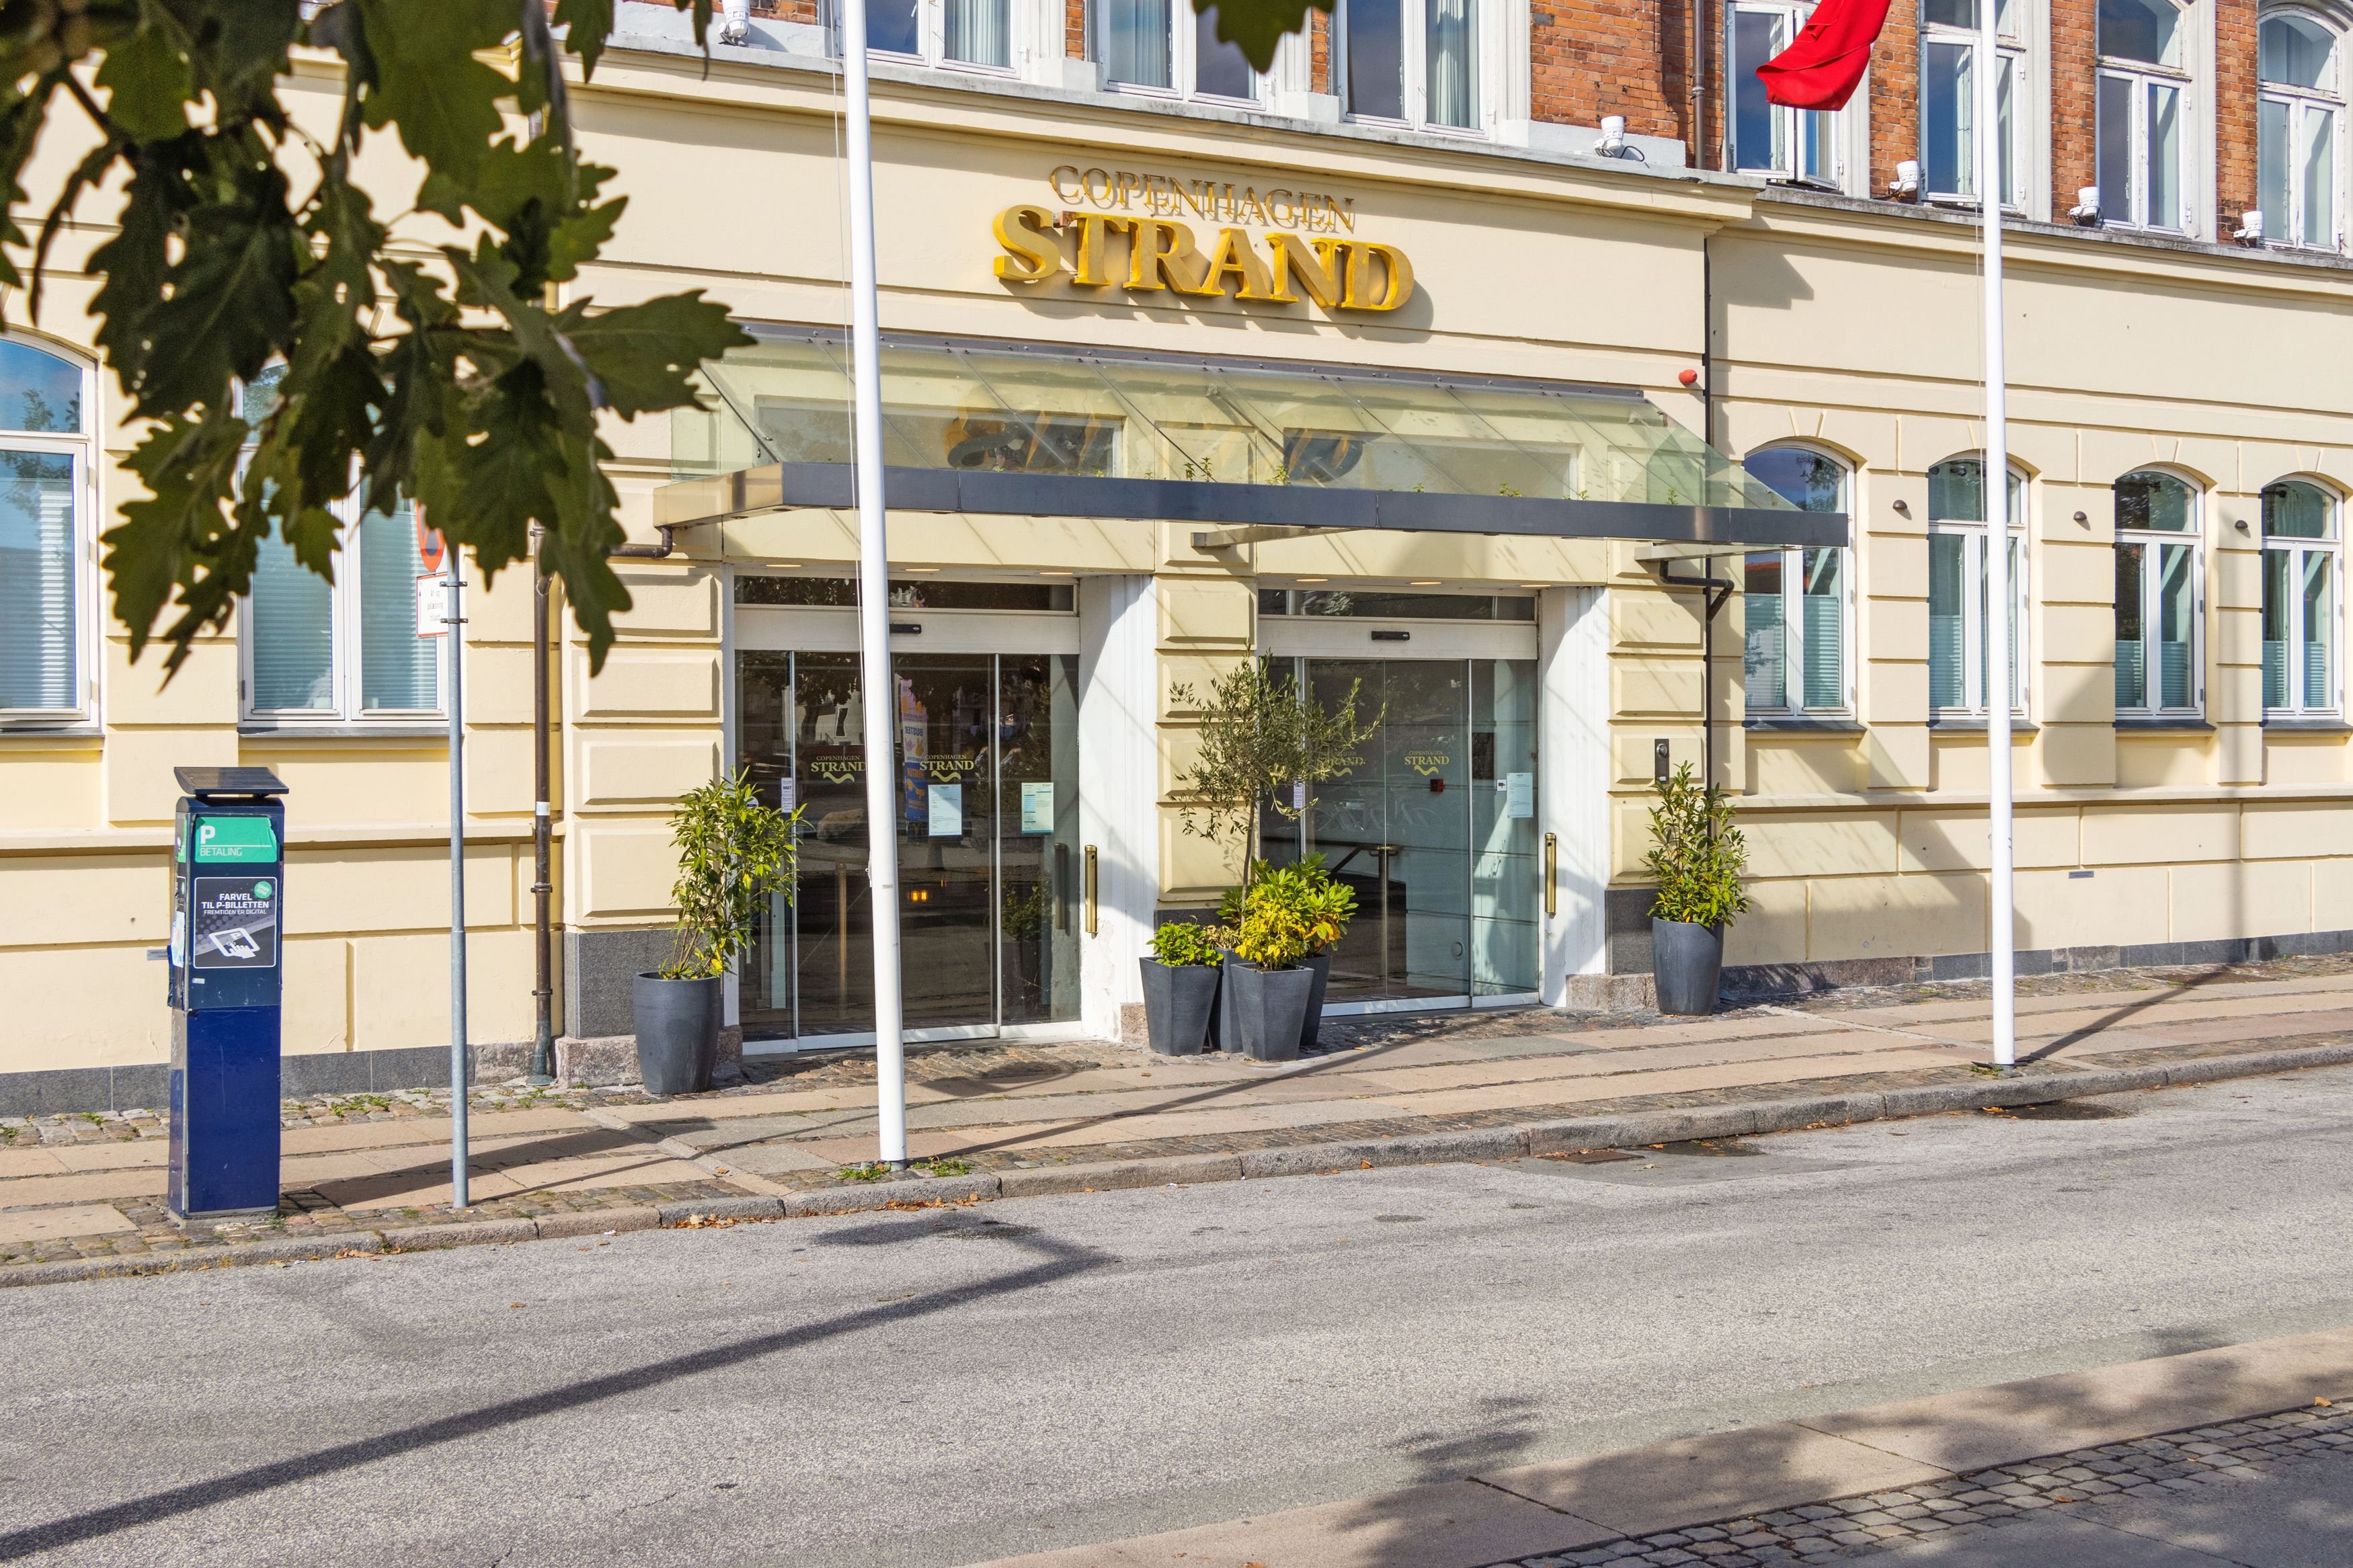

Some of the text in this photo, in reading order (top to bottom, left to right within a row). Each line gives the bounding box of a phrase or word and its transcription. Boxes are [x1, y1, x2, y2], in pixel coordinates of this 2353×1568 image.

[1049, 165, 1355, 231] COPENHAGEN
[993, 204, 1414, 311] STRAND
[920, 760, 974, 770] STRAND
[1404, 756, 1449, 765] STRAND
[811, 761, 866, 772] STRAND
[200, 825, 215, 844] P
[200, 848, 243, 856] BETALING
[216, 901, 269, 909] P-BILLETTEN
